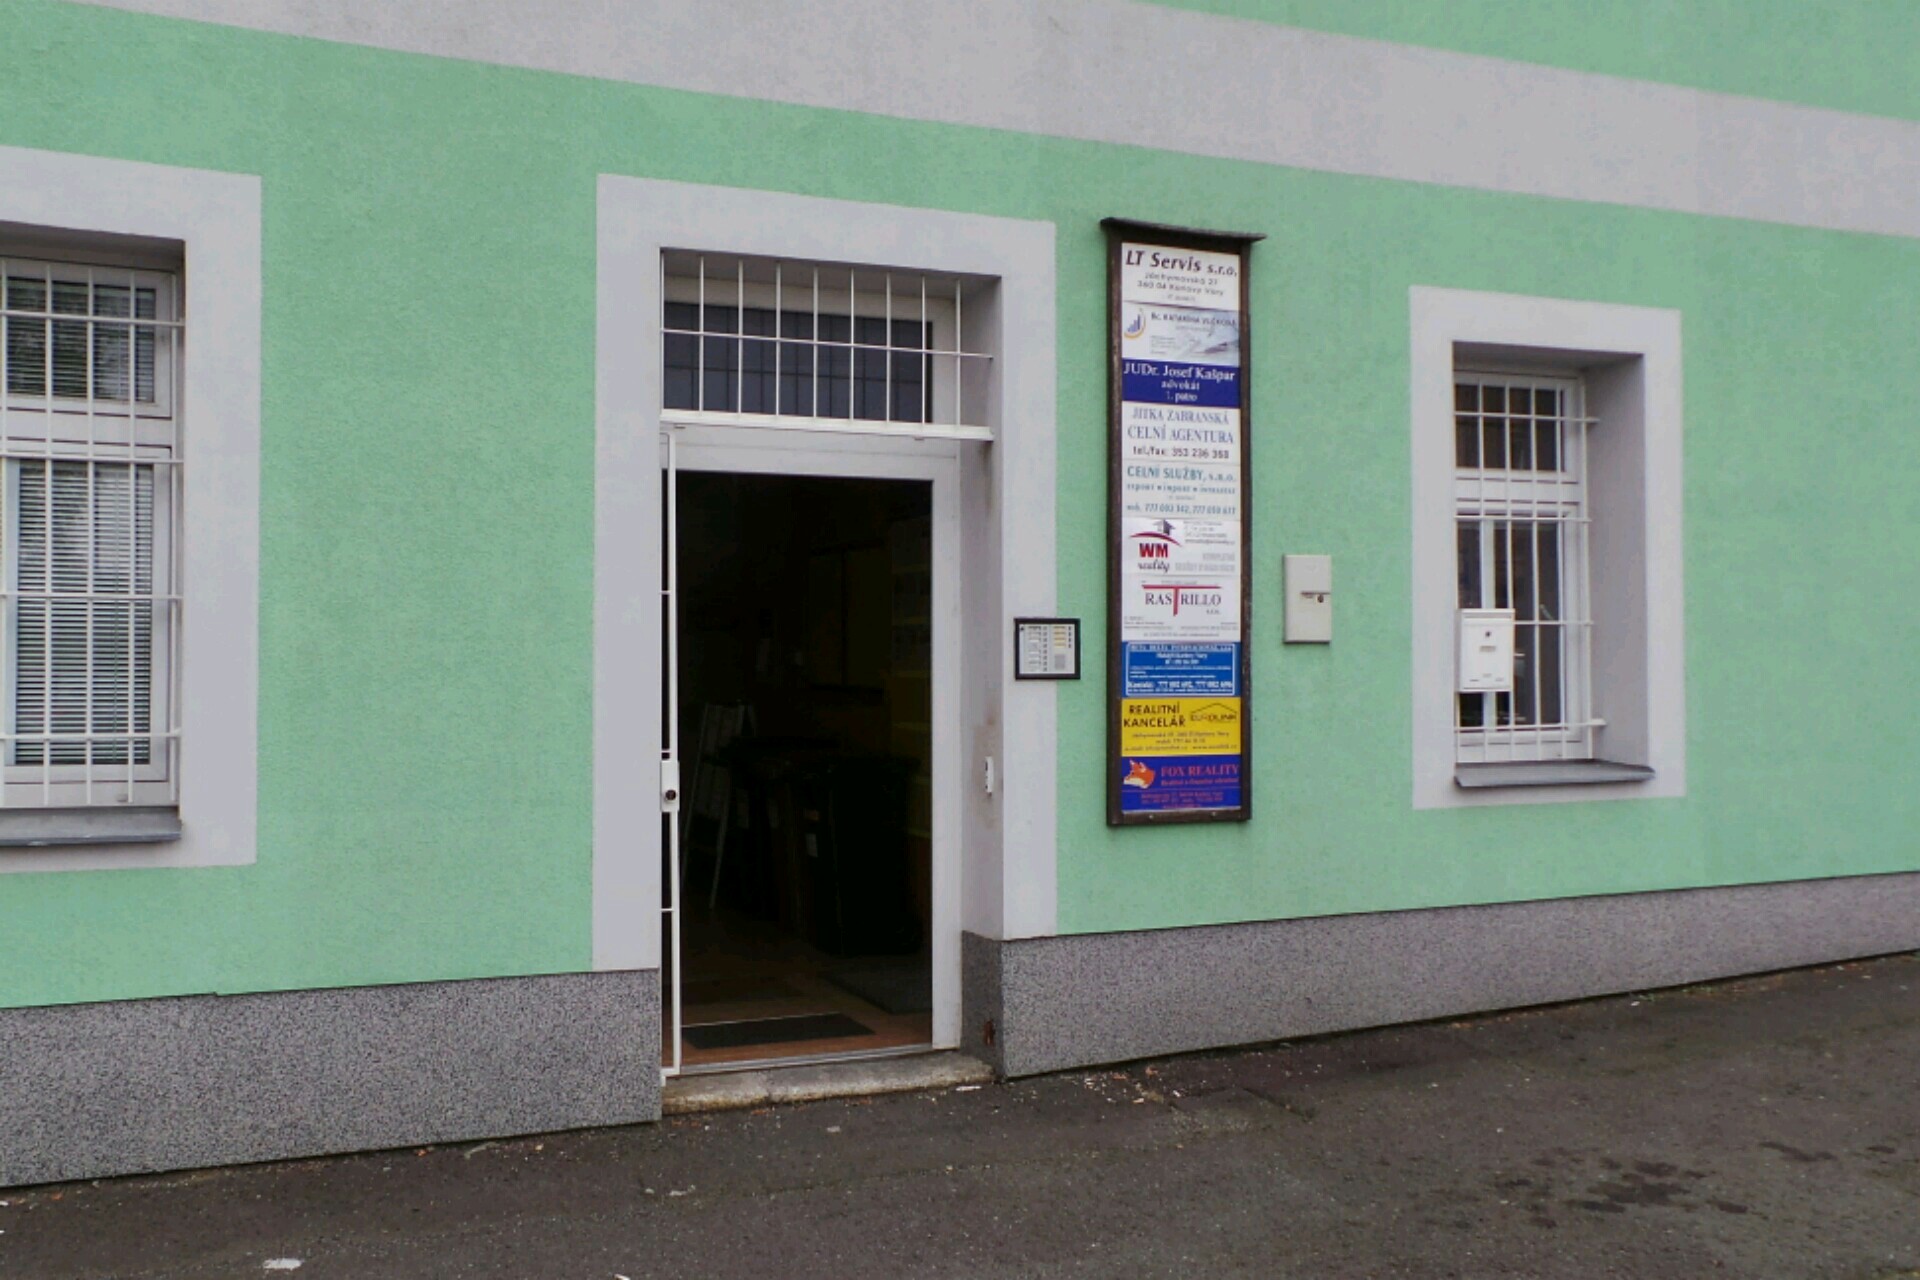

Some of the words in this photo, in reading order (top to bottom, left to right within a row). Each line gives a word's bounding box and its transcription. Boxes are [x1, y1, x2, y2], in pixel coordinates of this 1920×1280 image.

[1125, 250, 1145, 265] LT
[1150, 252, 1202, 272] Servis
[1123, 362, 1160, 376] JUDr.
[1163, 365, 1193, 379] Josef
[1195, 366, 1236, 384] Kašpar
[1127, 424, 1166, 440] CELNÍ
[1169, 428, 1234, 444] AGENTURA
[1139, 543, 1168, 558] WM
[1129, 701, 1180, 714] REALITNÍ
[1123, 715, 1186, 728] KANCELÁŘ
[1161, 766, 1185, 777] FOX
[1188, 764, 1239, 776] REALITY
